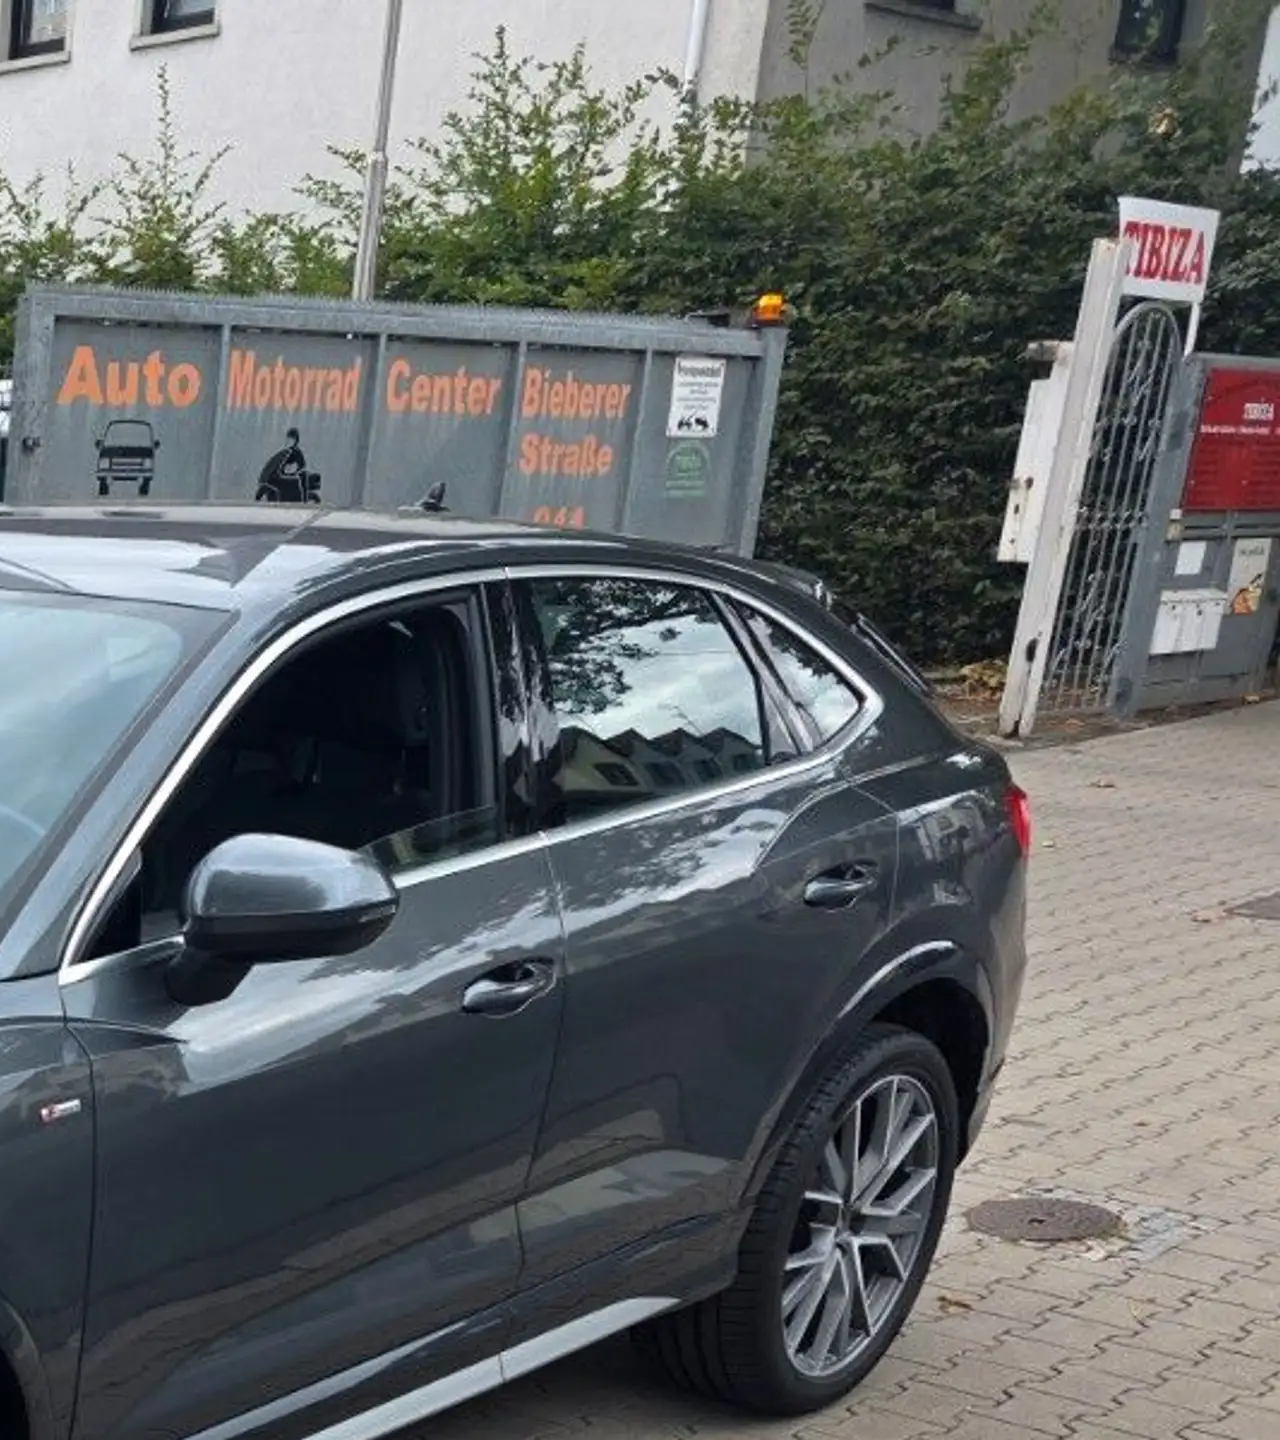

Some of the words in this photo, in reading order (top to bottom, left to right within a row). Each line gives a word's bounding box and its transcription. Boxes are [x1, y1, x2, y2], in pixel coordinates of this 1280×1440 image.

[56, 345, 201, 406] Auto
[227, 350, 362, 412] Motorrad
[387, 356, 501, 415] Center
[522, 367, 631, 418] Bieberer
[519, 432, 614, 477] Straße
